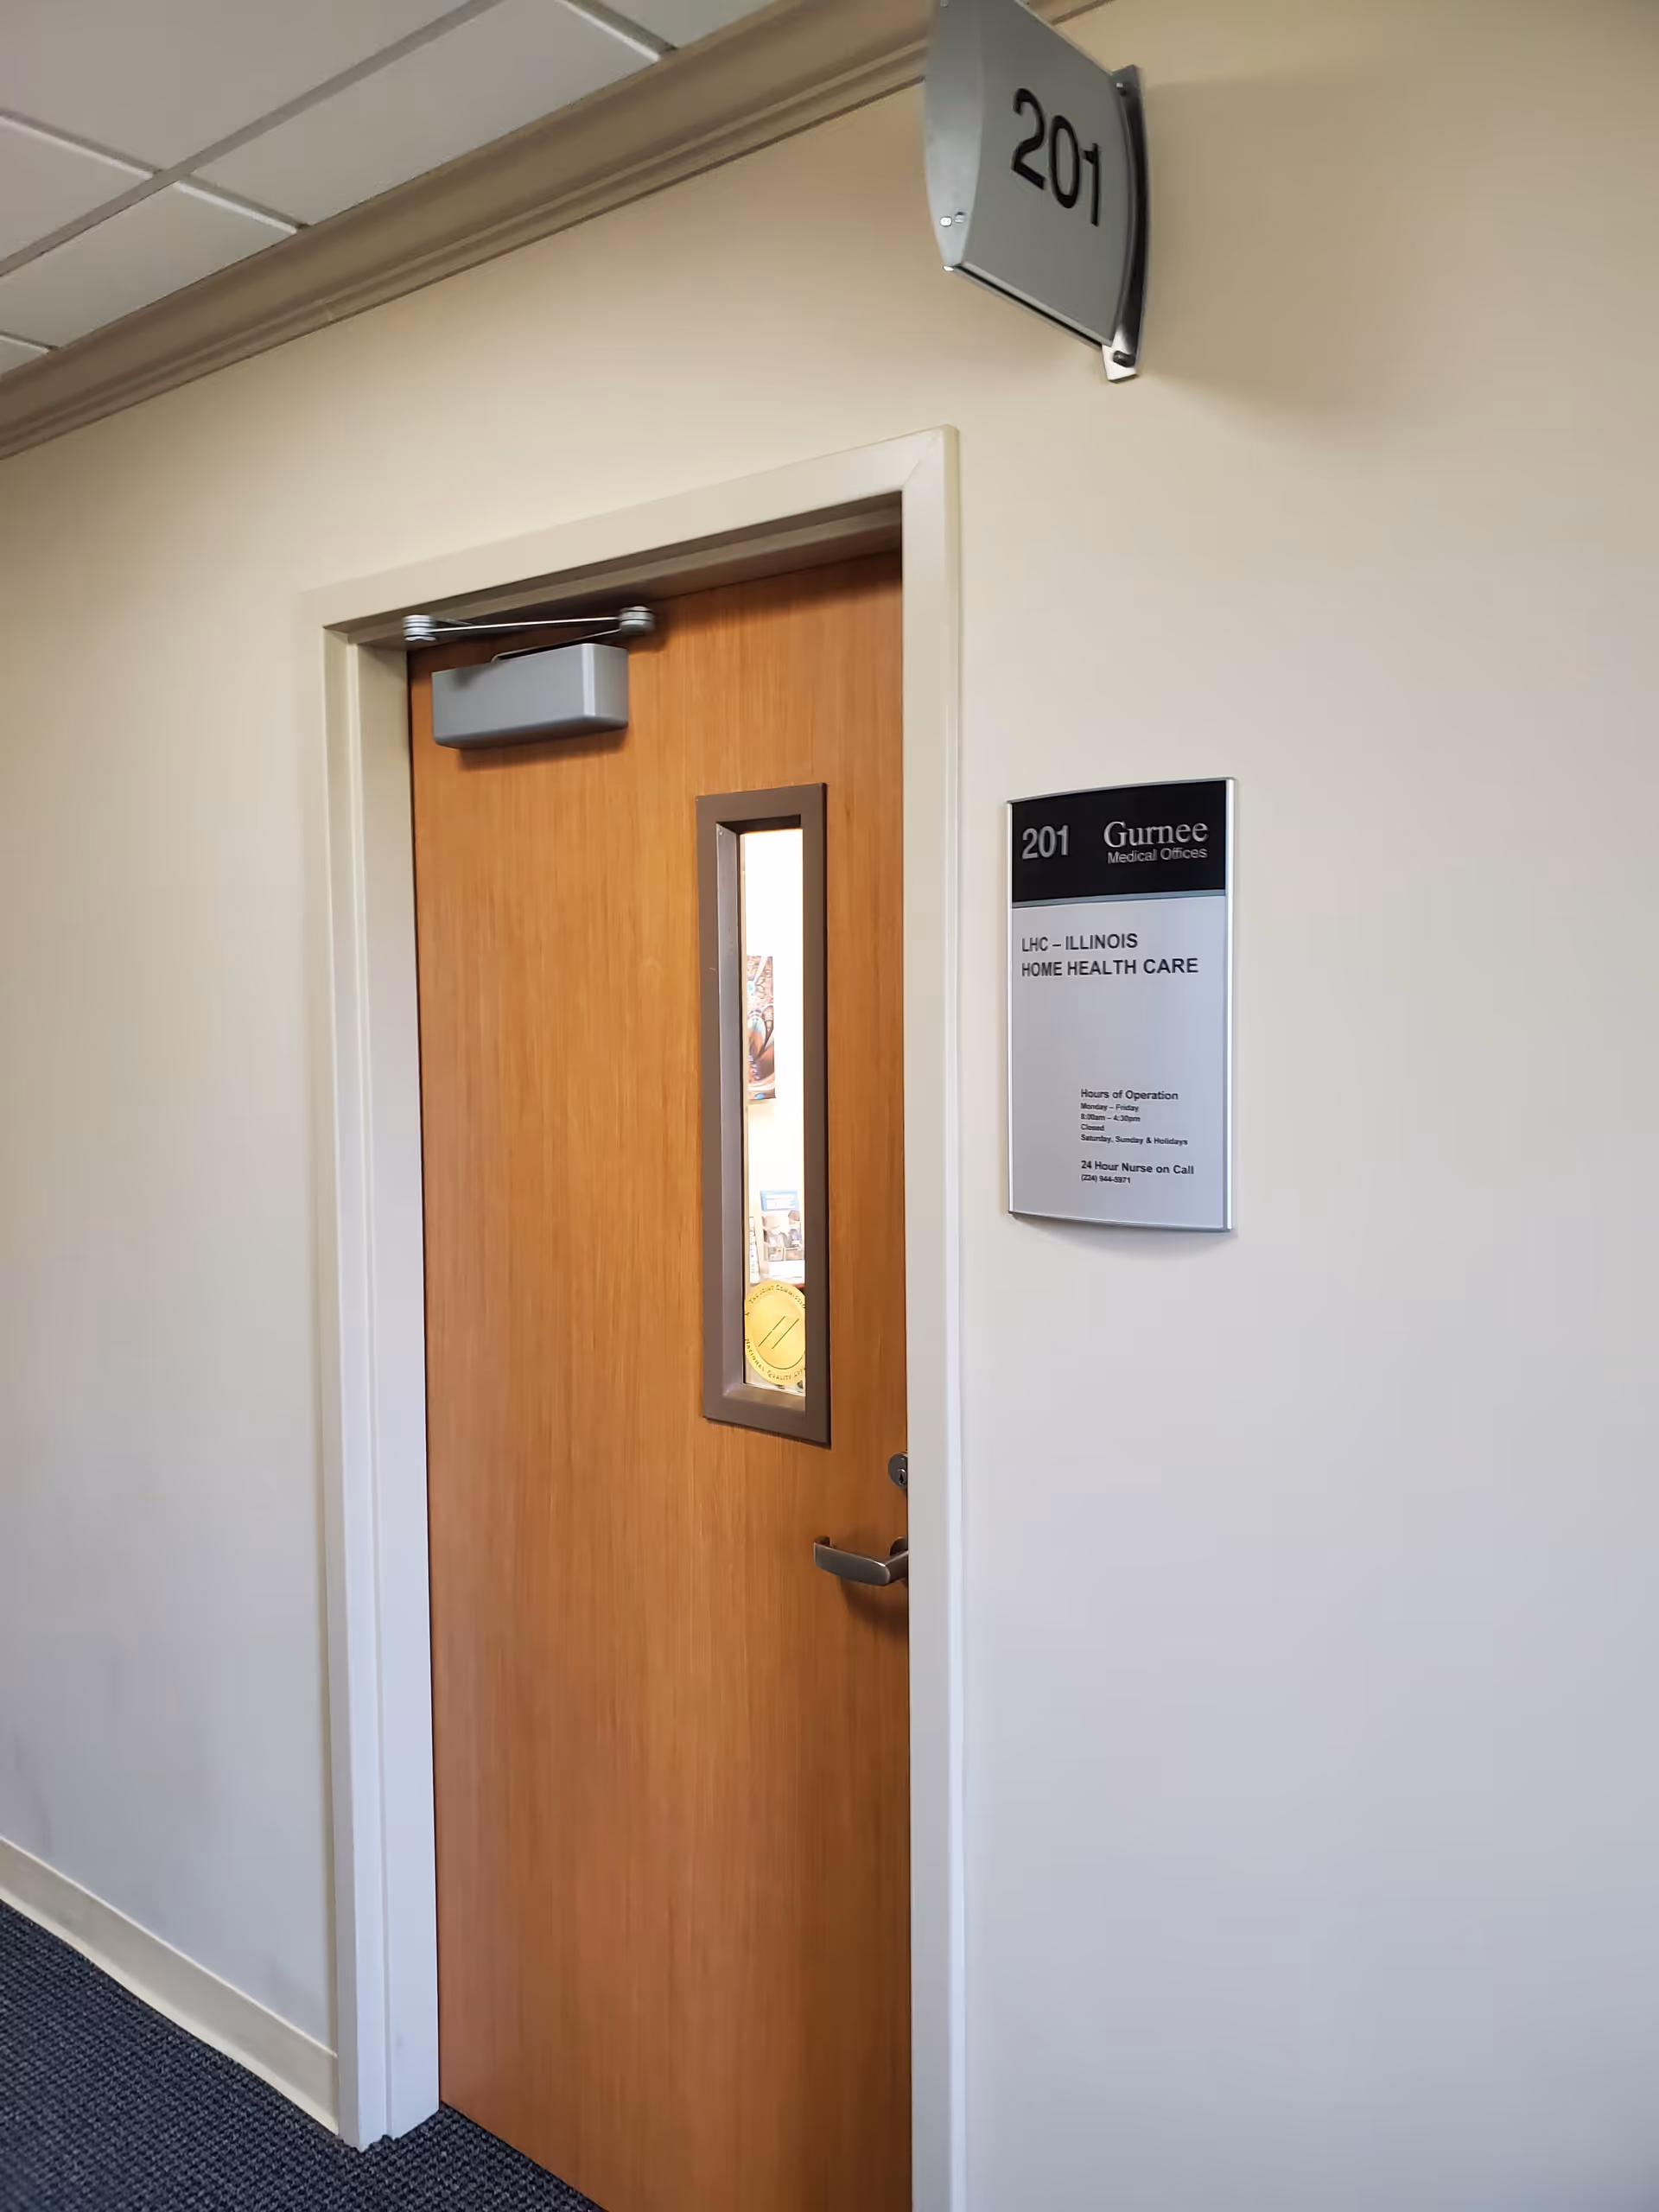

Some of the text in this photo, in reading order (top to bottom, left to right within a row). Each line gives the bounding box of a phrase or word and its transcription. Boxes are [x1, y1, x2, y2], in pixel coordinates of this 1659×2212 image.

[1010, 87, 1101, 227] 201
[1021, 824, 1070, 860] 201
[1103, 821, 1210, 848] Gurnee
[1108, 847, 1208, 864] Medical Offices
[1021, 936, 1049, 952] LHC
[1065, 933, 1139, 950] ILLINOIS
[1021, 957, 1199, 977] HOME HEALTH CARE
[1080, 1089, 1179, 1102] Hours of Operation
[1080, 1103, 1108, 1111] Monday
[1116, 1103, 1139, 1113] Friday
[1116, 1135, 1143, 1145] Sunday
[1154, 1137, 1188, 1147] Holidays
[1081, 1160, 1194, 1175] 24 Hour Nurse on Call
